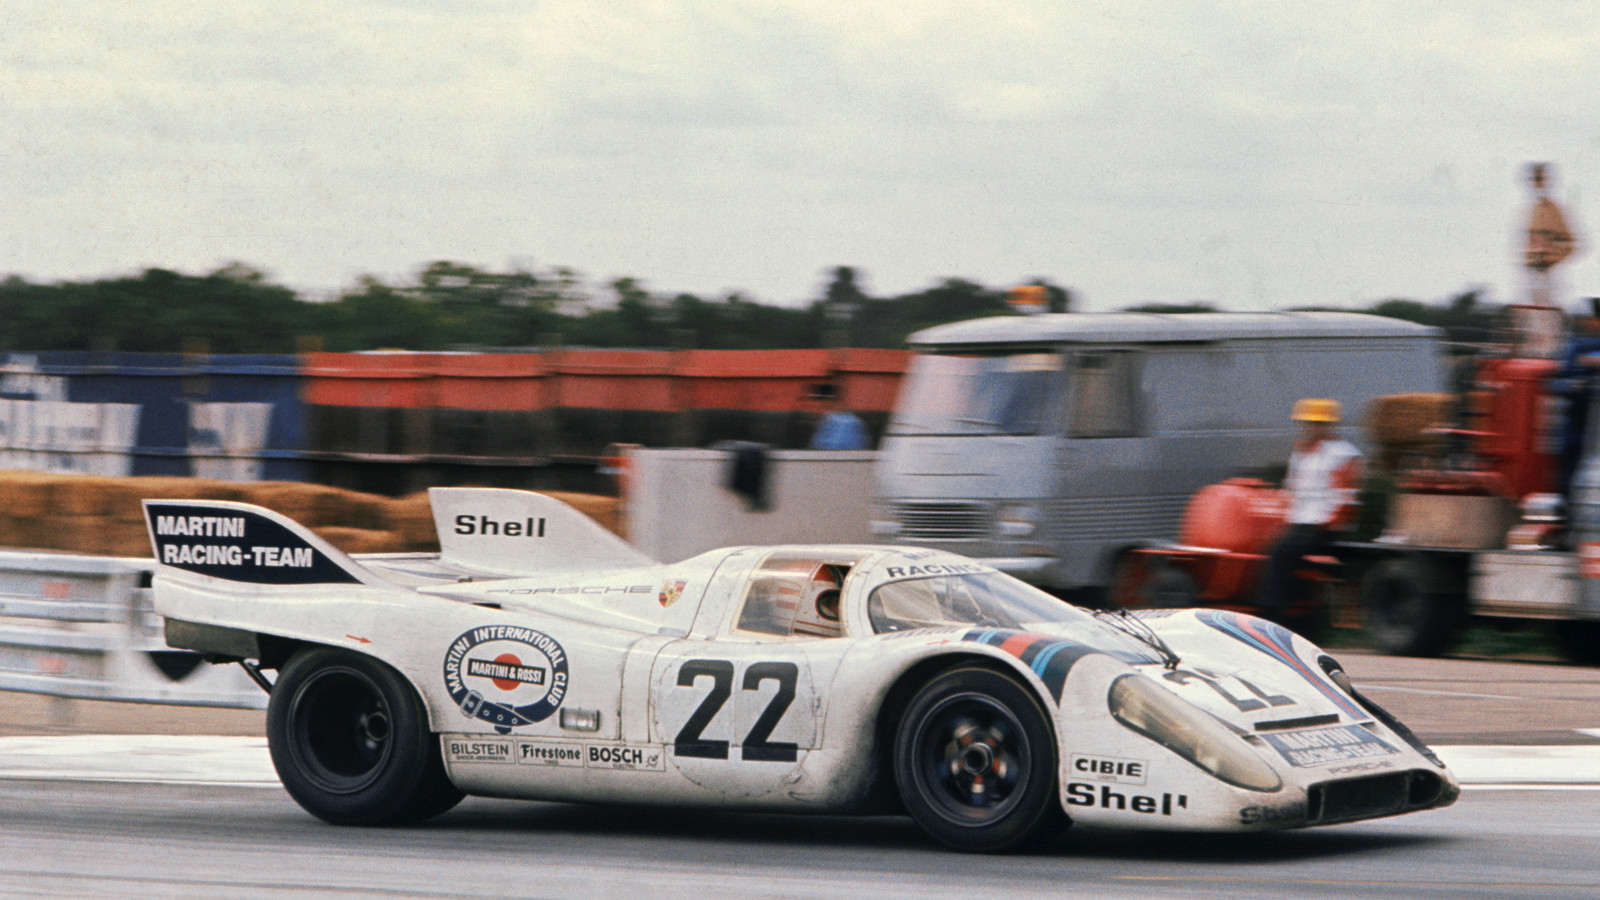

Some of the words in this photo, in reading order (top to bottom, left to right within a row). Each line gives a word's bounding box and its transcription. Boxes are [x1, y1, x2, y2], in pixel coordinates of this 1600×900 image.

[157, 515, 245, 538] MARTINI
[454, 514, 546, 537] Shell
[163, 544, 313, 568] RACING-TEAM
[486, 585, 653, 595] PORSCHE
[446, 637, 470, 694] MARTINI
[473, 626, 564, 668] INTERNATIONAL
[547, 671, 567, 707] CLUB
[471, 661, 509, 679] MARTINI
[509, 668, 517, 679] &
[517, 668, 542, 683] ROSSI
[674, 659, 799, 763] 22
[451, 743, 509, 755] BILSTEIN
[1272, 726, 1363, 750] MARTINI
[520, 744, 581, 760] Firestone
[589, 747, 643, 764] BOSCH
[1075, 758, 1143, 777] CIBIE
